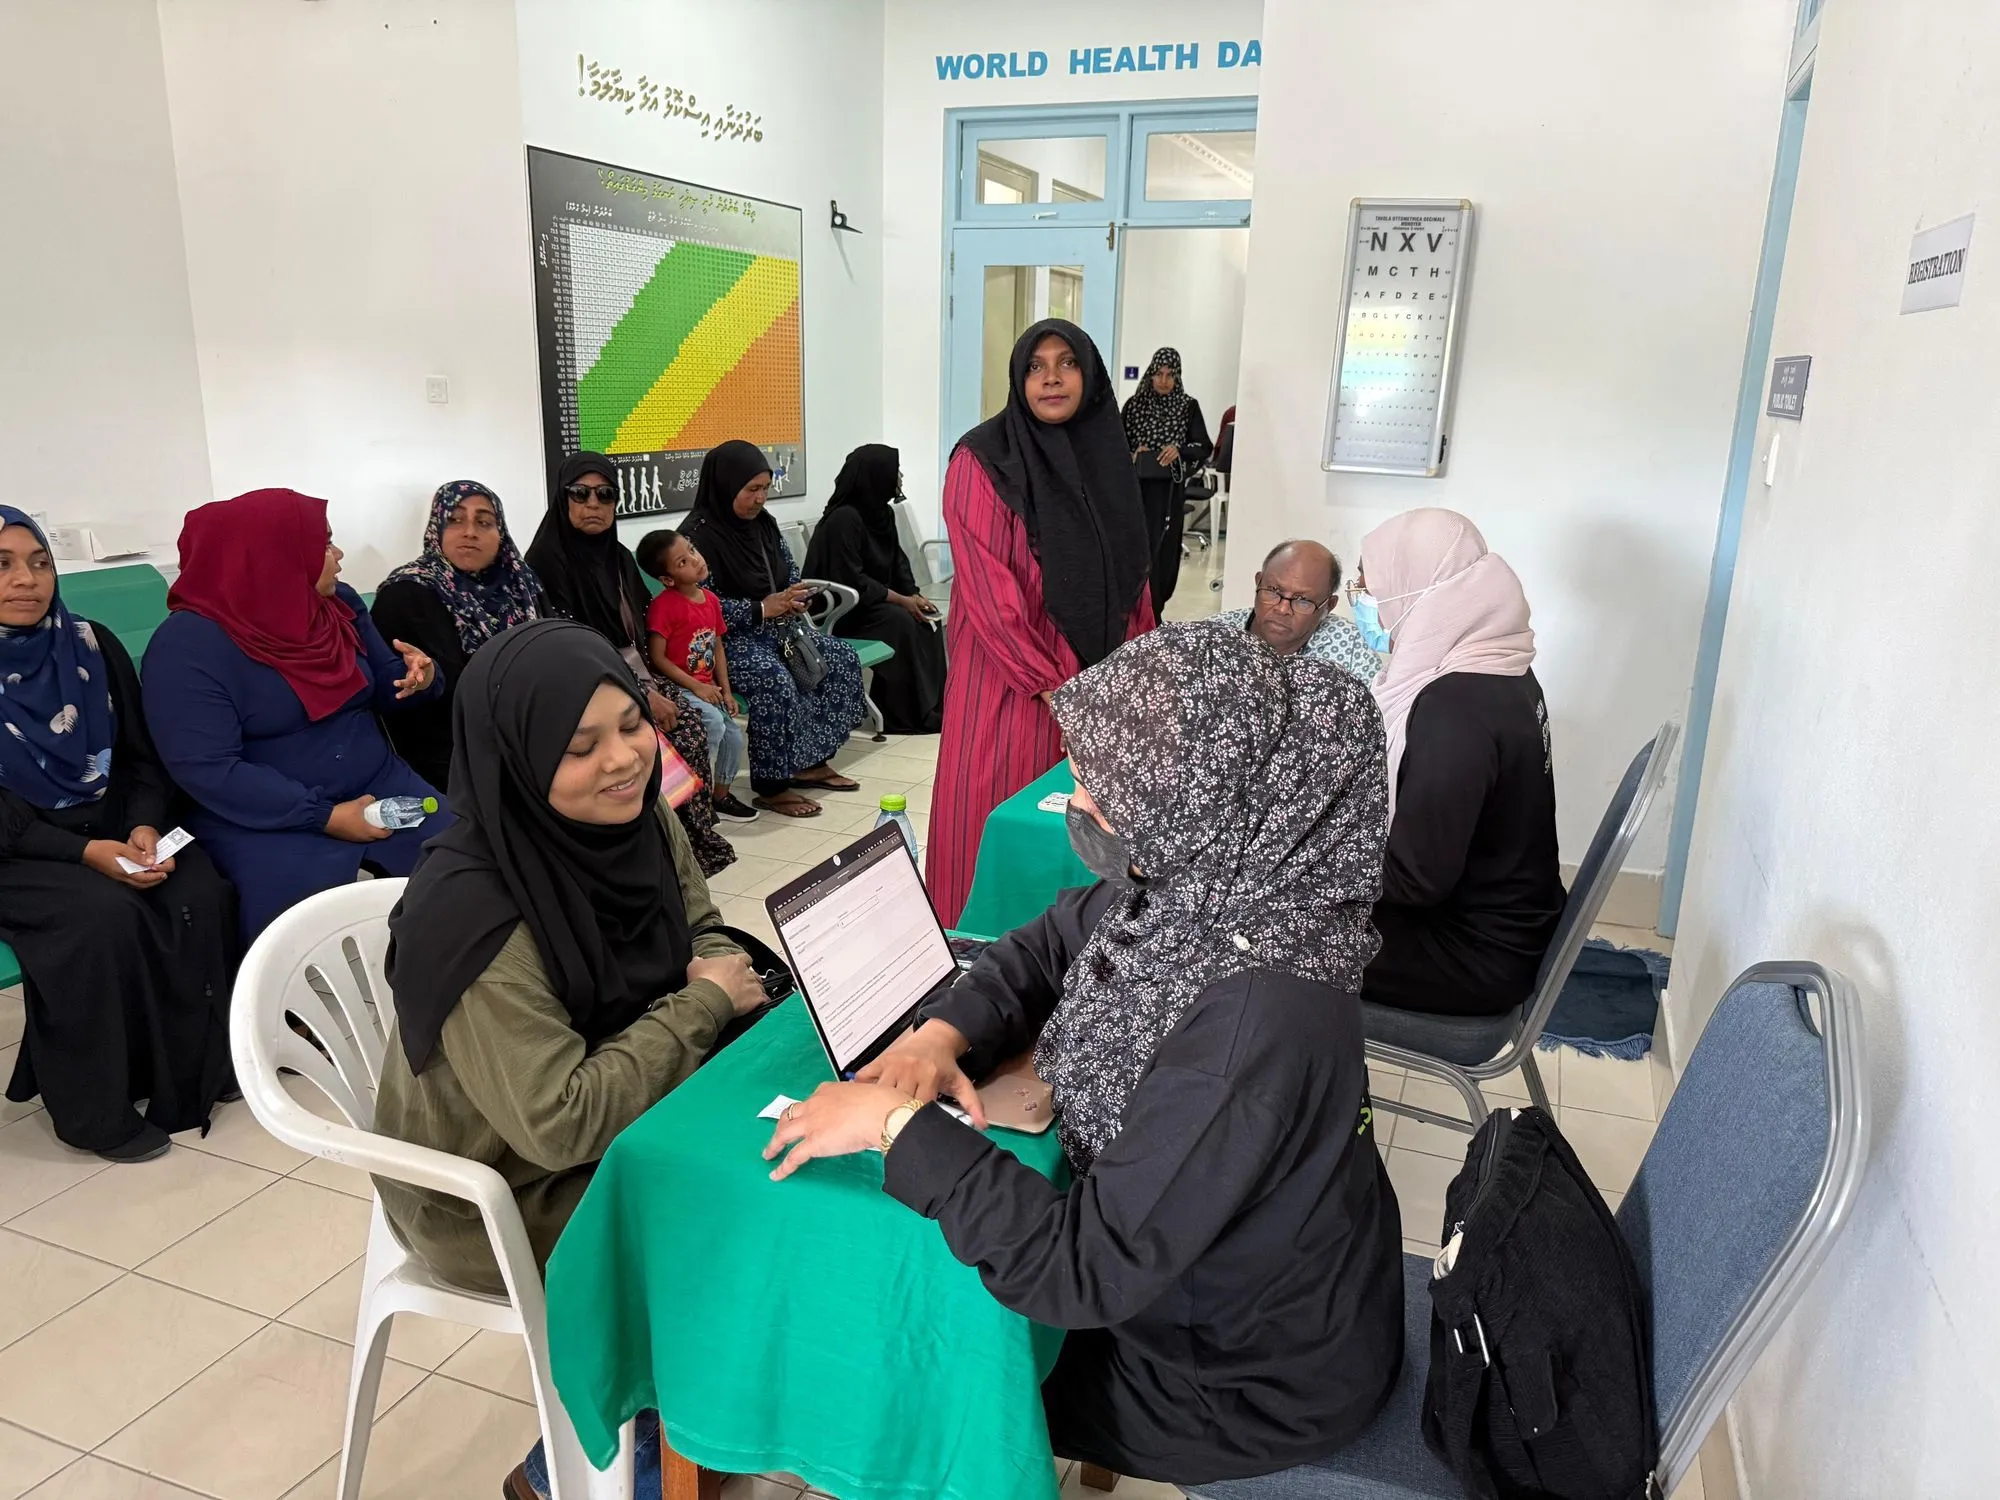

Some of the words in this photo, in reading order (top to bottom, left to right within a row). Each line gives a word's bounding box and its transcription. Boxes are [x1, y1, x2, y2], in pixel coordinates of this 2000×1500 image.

[936, 51, 1048, 80] WORLD
[1069, 43, 1199, 74] HEALTH
[1217, 40, 1262, 68] DA
[1370, 232, 1388, 252] N
[1398, 232, 1416, 253] X
[1427, 233, 1443, 253] V
[1907, 248, 1965, 284] REGISTRATION
